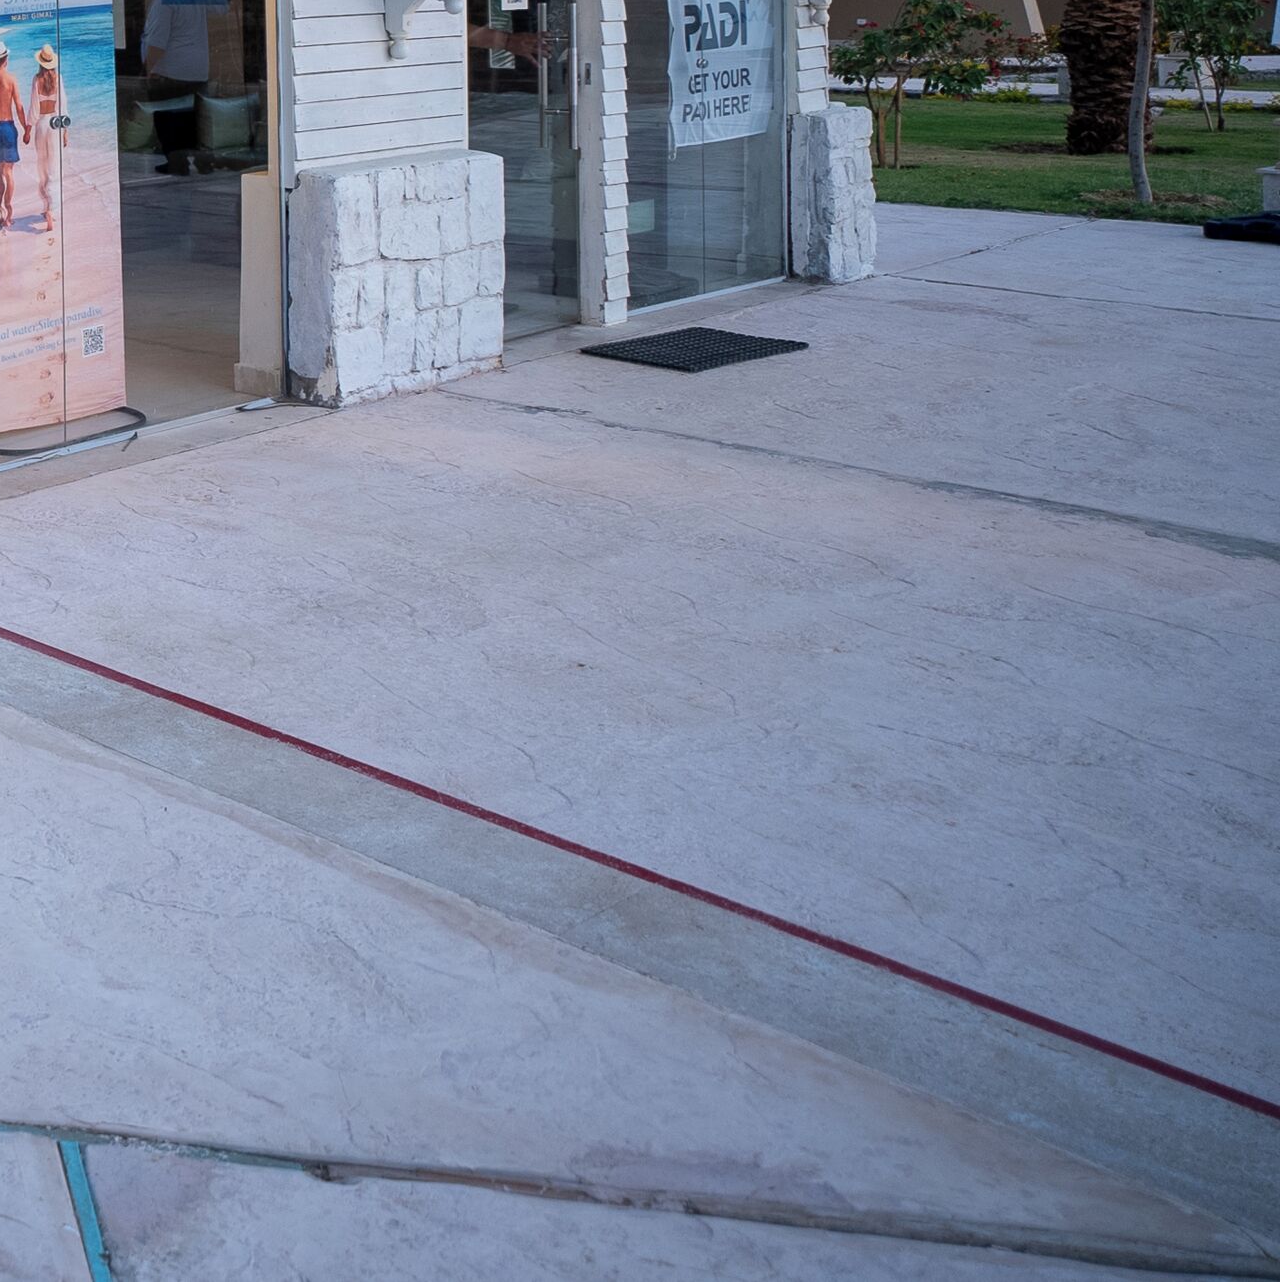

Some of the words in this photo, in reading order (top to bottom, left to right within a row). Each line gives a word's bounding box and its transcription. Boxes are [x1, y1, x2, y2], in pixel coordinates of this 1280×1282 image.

[684, 0, 747, 53] PADI
[712, 68, 752, 91] YOUR
[682, 101, 711, 123] PADI
